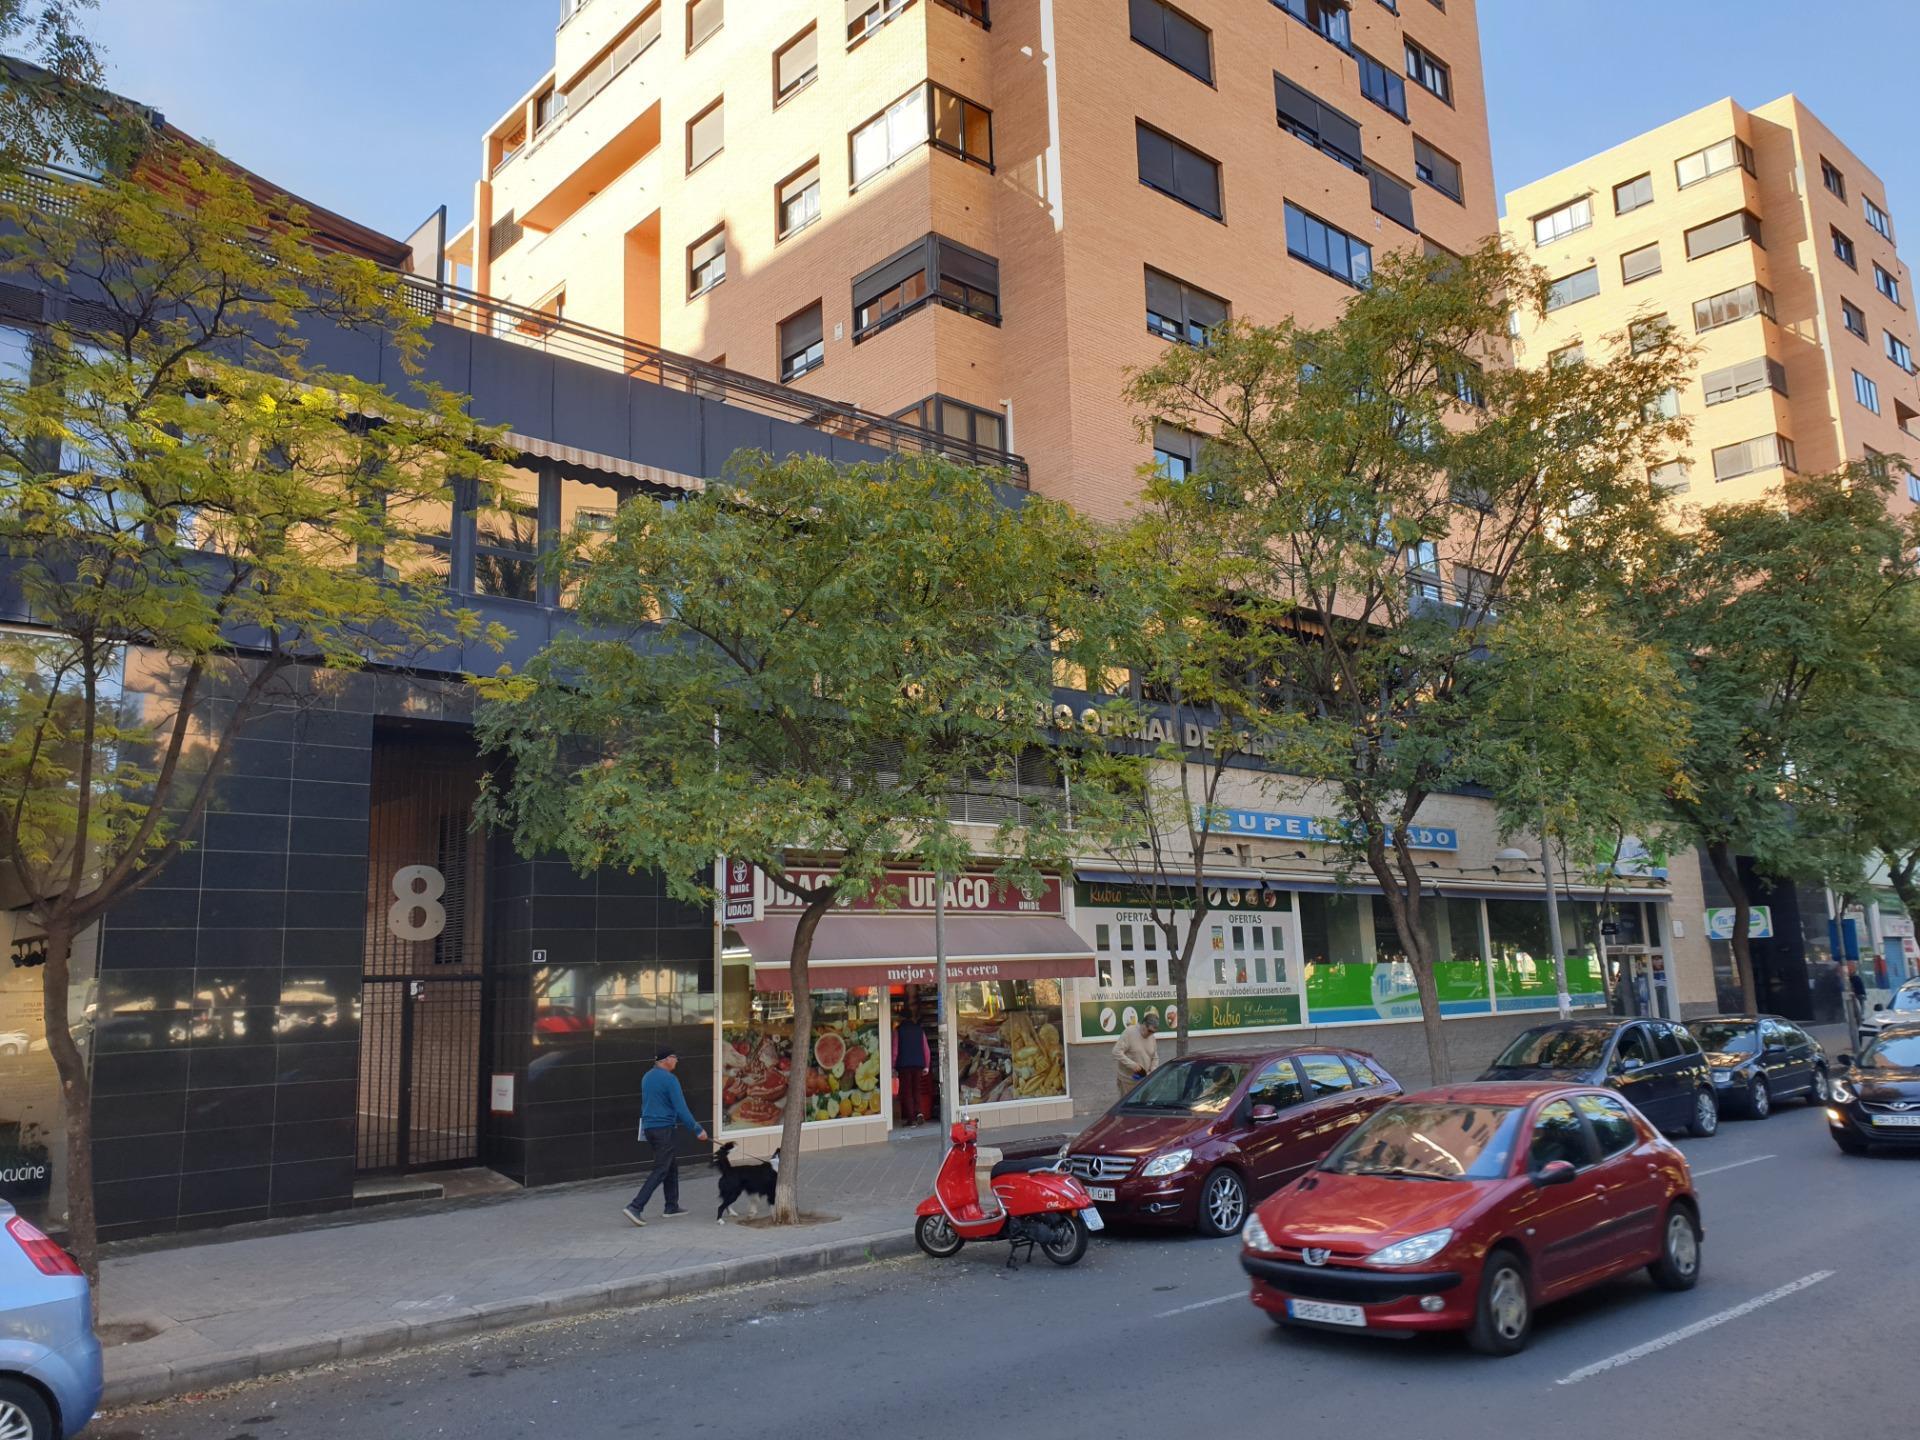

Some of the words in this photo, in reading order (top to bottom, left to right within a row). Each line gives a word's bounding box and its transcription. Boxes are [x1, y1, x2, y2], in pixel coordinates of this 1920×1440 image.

[908, 876, 990, 909] UDACO
[388, 864, 446, 941] 8
[727, 903, 752, 917] UDACO
[1116, 911, 1154, 923] OFERTAS
[1229, 913, 1262, 925] OFERTAS
[887, 965, 926, 983] mejor
[966, 964, 999, 977] cerca
[1212, 1001, 1241, 1028] Rubio
